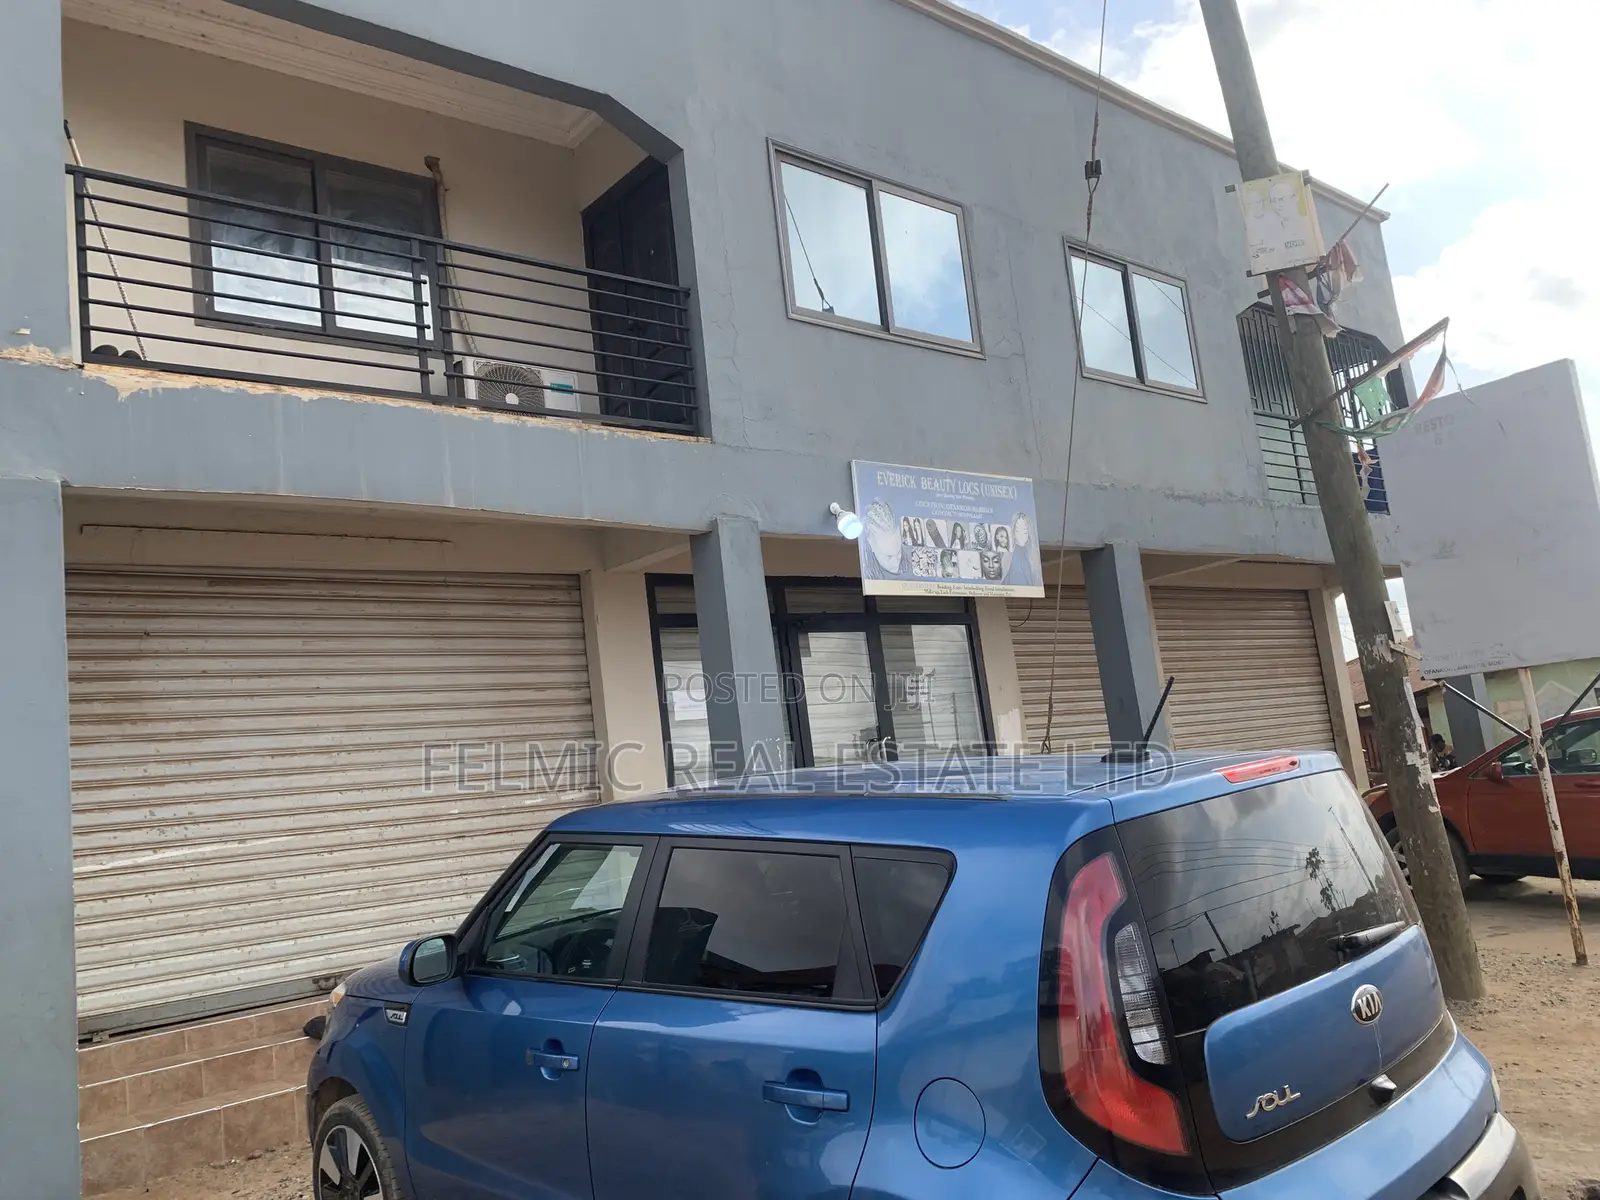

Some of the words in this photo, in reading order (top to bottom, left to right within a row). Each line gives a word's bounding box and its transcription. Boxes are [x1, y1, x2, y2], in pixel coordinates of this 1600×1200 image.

[877, 471, 917, 488] EVERICK
[920, 476, 957, 494] BEAUTY
[958, 480, 979, 495] LOCS
[980, 483, 1018, 500] (UNISEX)
[1357, 993, 1382, 1019] KIA
[1246, 1084, 1302, 1119] SOUL
